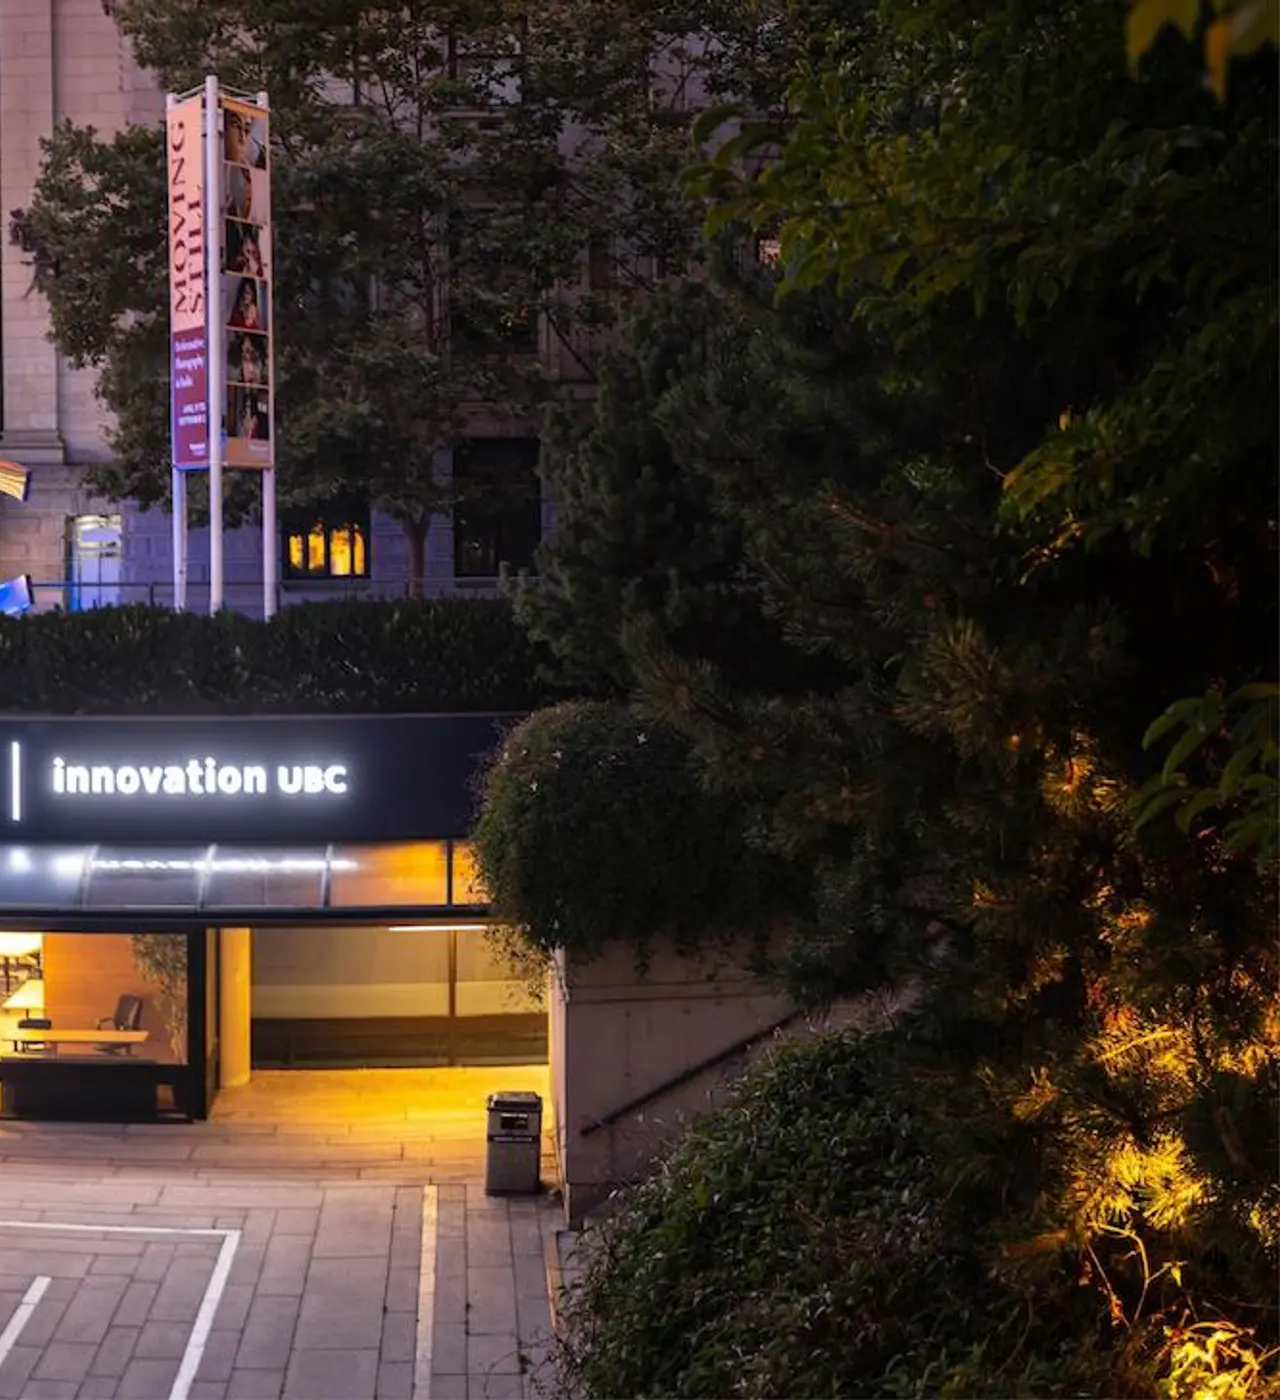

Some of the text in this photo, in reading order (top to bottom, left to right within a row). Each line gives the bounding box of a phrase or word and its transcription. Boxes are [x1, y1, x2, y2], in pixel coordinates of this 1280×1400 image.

[170, 121, 187, 313] MOVING
[187, 184, 203, 315] STILL
[52, 756, 348, 795] innovation UBC
